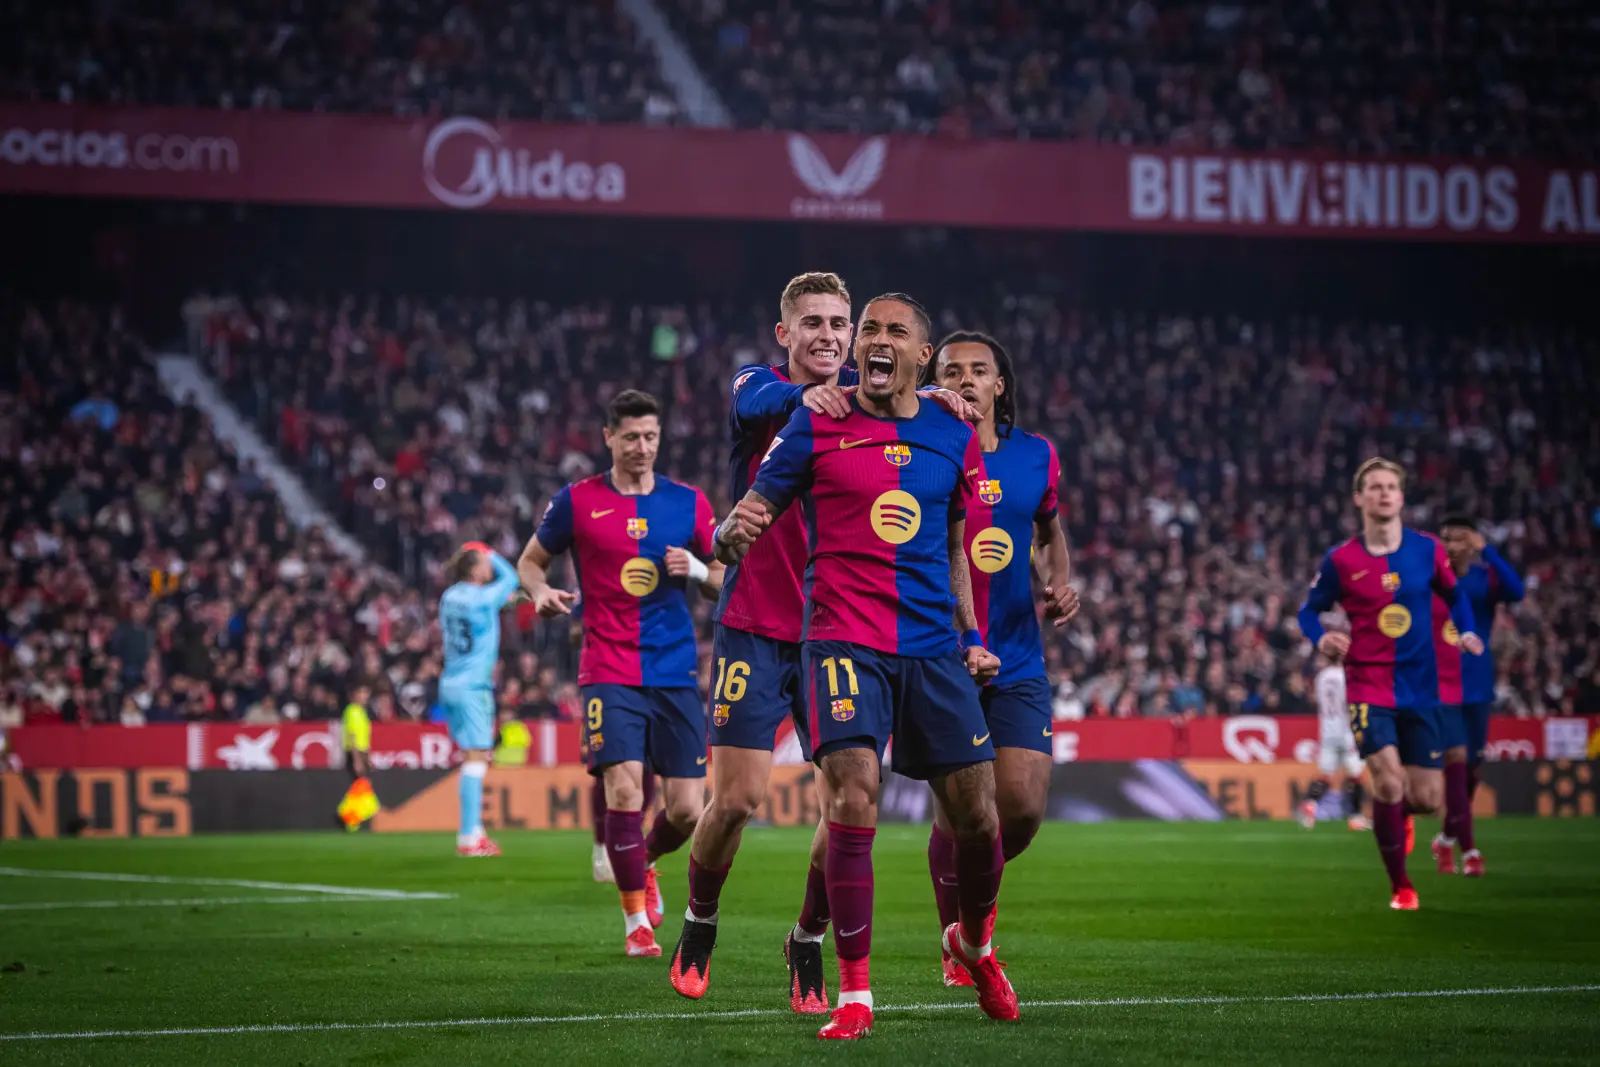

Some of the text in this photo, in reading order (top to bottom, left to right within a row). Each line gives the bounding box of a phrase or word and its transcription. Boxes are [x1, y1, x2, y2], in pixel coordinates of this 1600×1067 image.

[0, 129, 240, 174] ocios.com
[424, 117, 626, 208] Midea
[714, 657, 751, 701] 16
[821, 657, 859, 696] 11
[588, 697, 603, 731] 9
